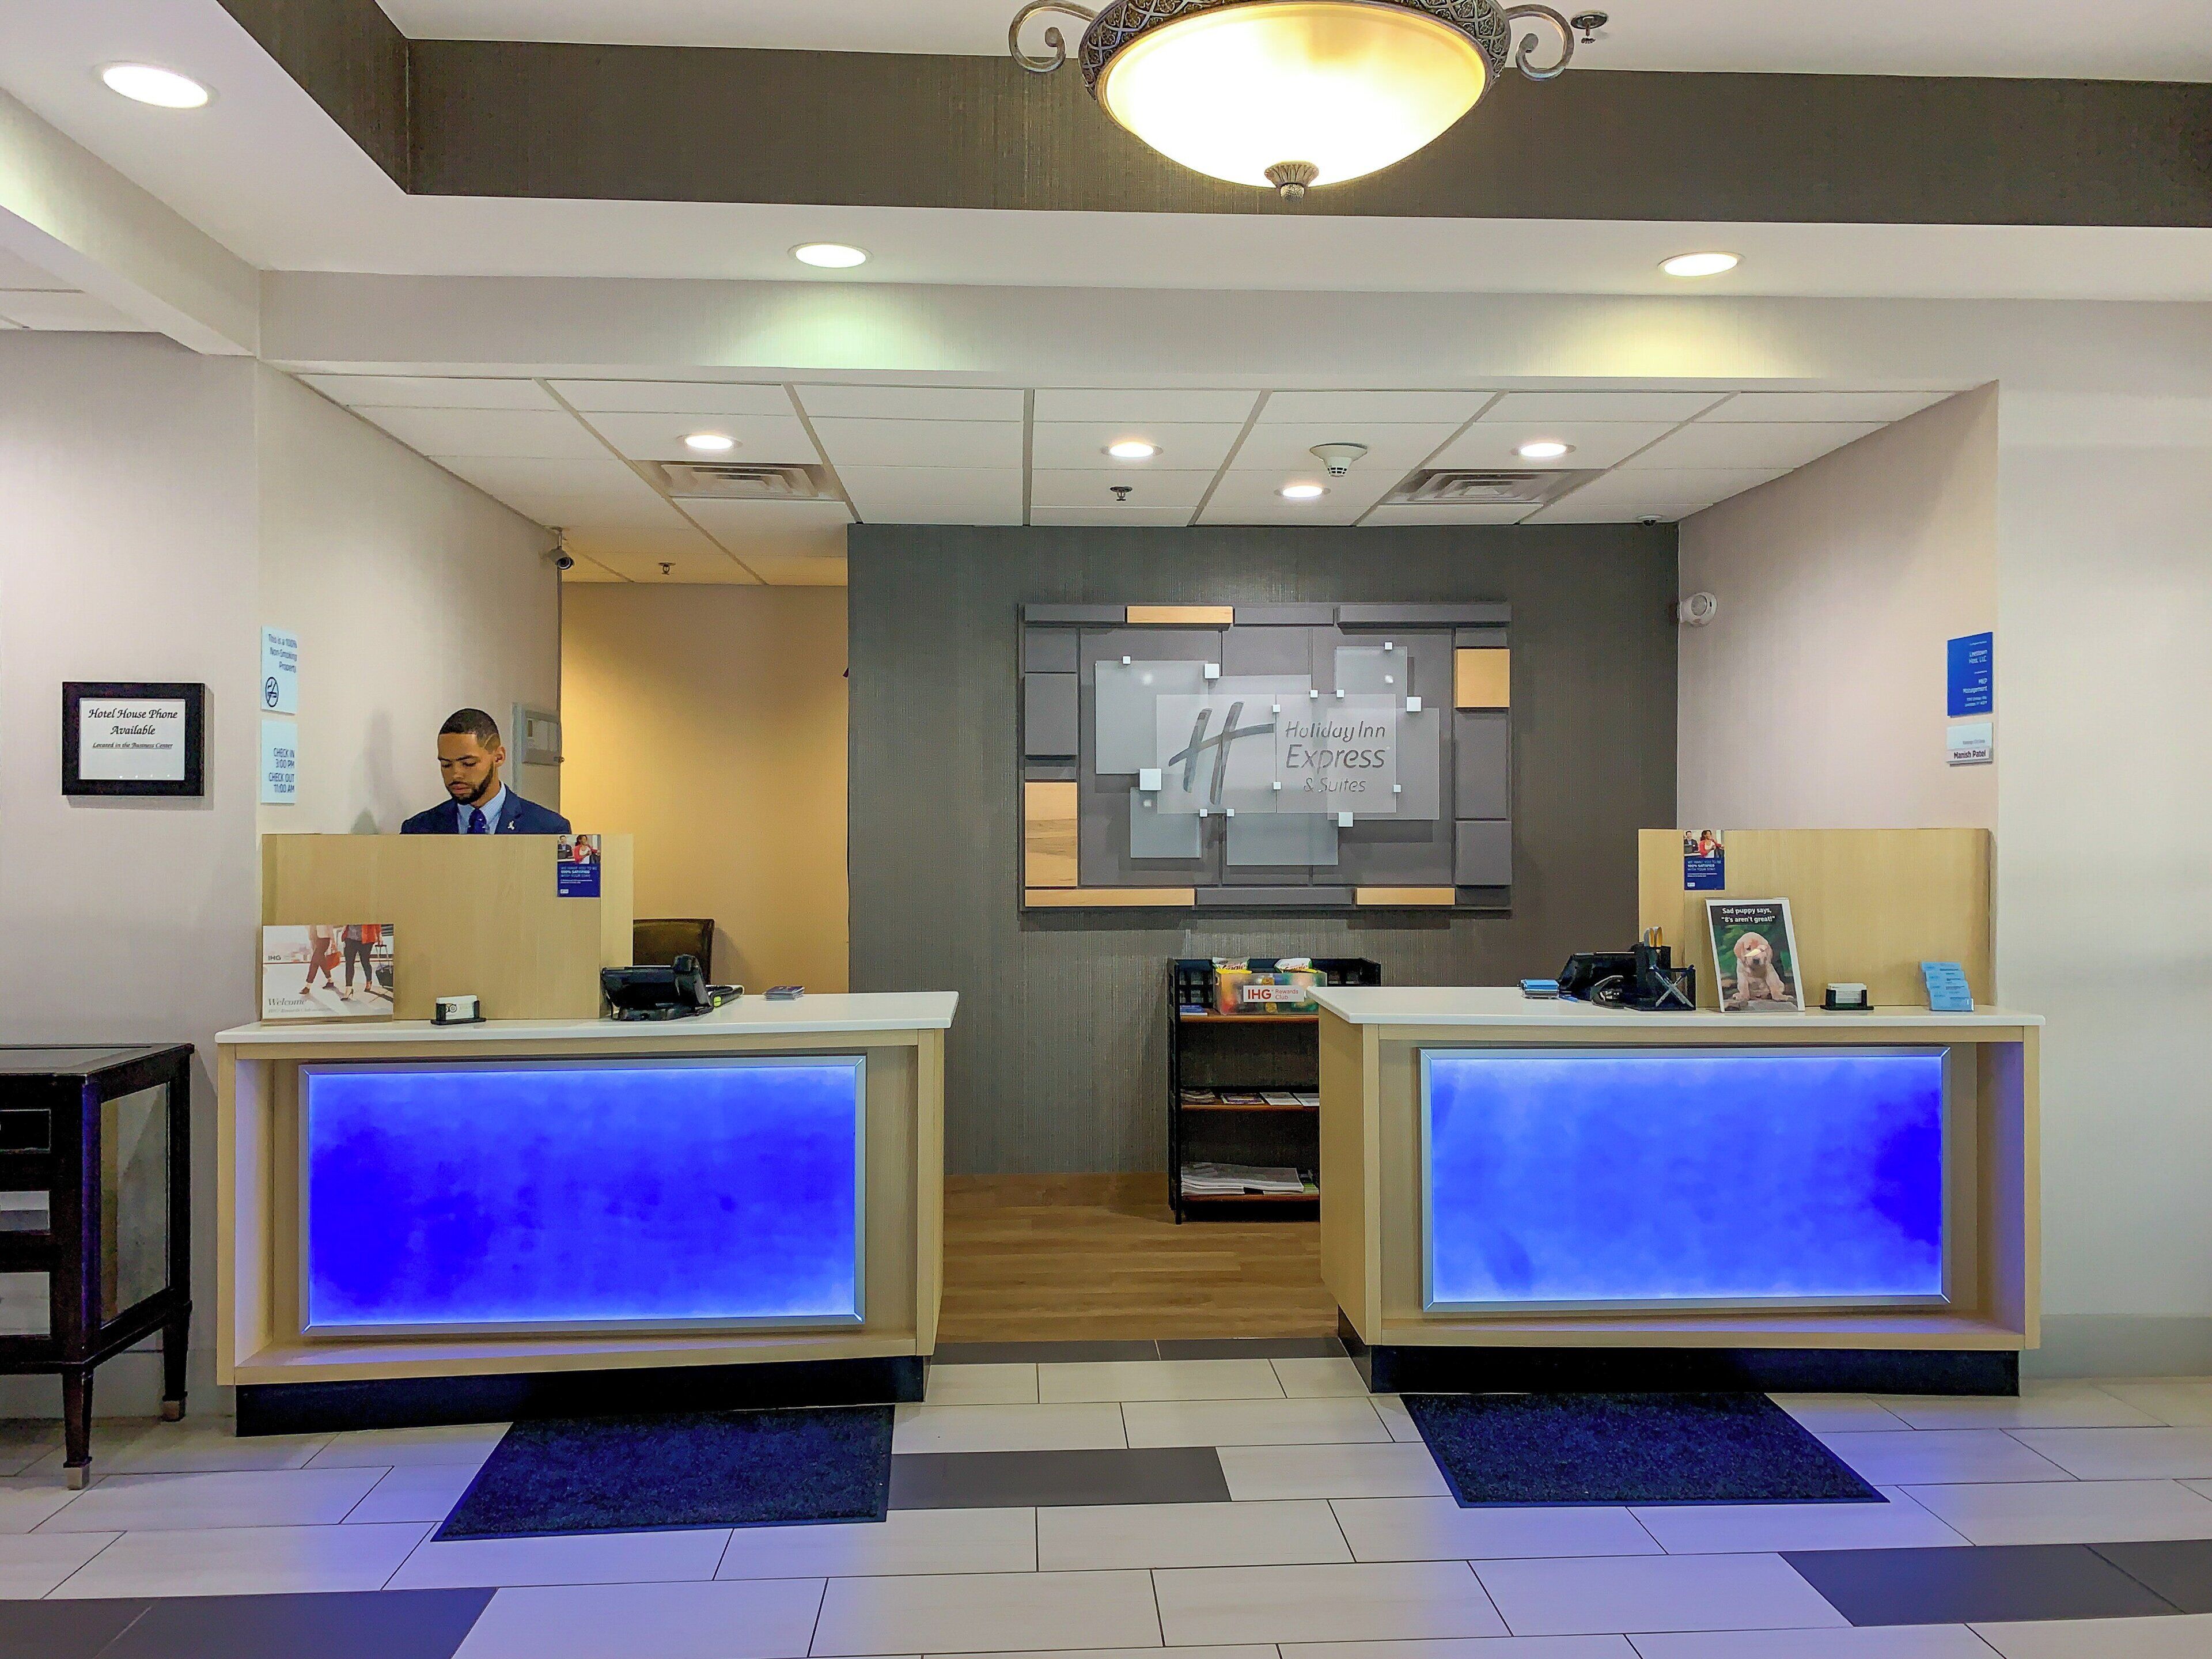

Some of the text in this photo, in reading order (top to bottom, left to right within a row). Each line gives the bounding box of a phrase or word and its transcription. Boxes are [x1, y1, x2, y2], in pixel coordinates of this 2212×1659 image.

[88, 707, 178, 719] Hotel House Phone
[110, 724, 156, 735] Available
[1285, 720, 1385, 743] Holiday Inn
[274, 747, 295, 758] CHECK IN
[1953, 749, 1986, 759] Manish Patel
[276, 758, 295, 769] 3:00 PM
[1286, 744, 1385, 775] Express
[269, 772, 294, 783] CHECK OUT
[287, 784, 295, 793] AM
[1304, 777, 1366, 793] & Suites
[1753, 915, 1775, 923] great!"
[1248, 989, 1272, 999] IHG
